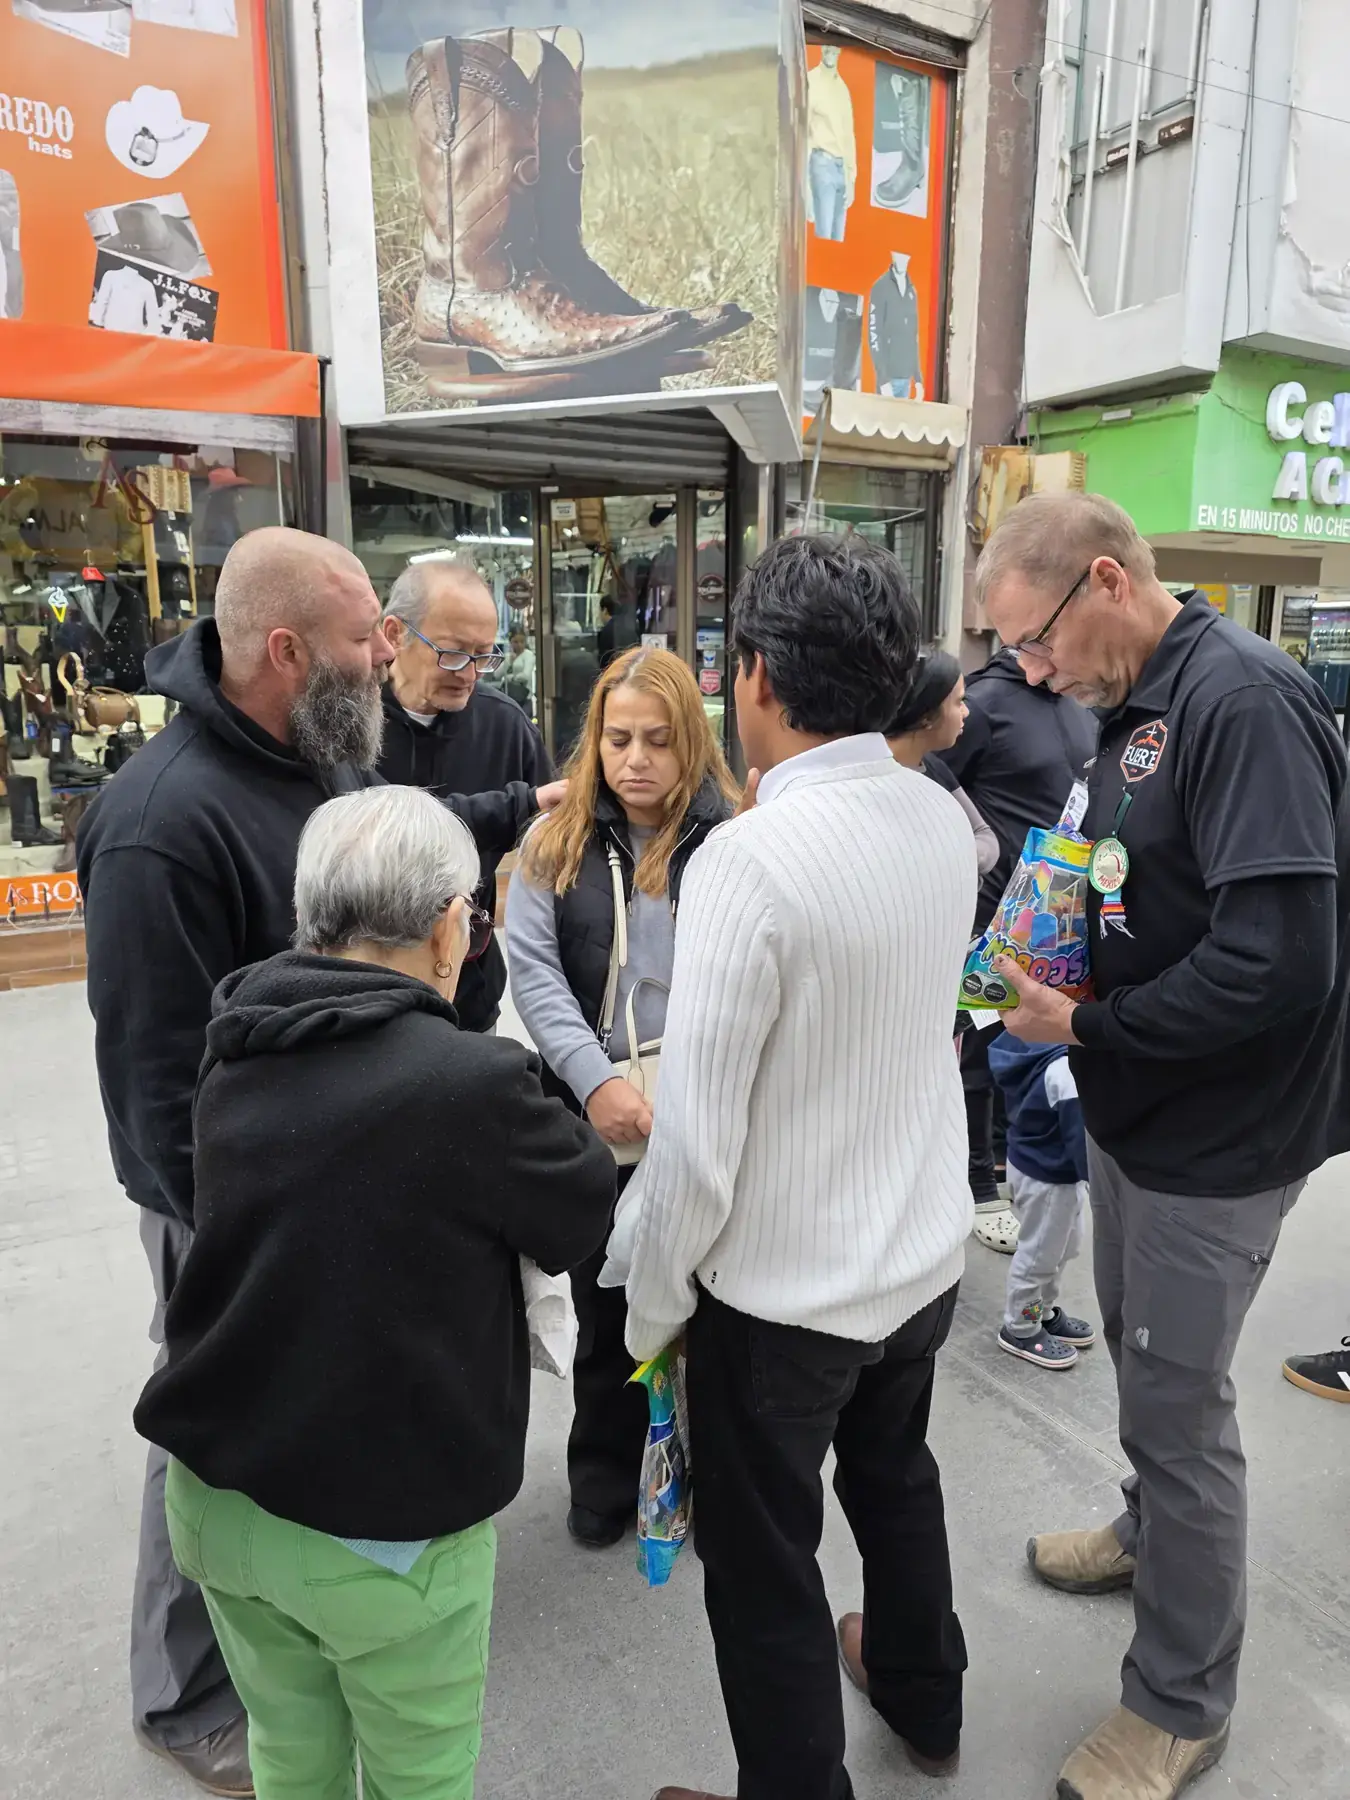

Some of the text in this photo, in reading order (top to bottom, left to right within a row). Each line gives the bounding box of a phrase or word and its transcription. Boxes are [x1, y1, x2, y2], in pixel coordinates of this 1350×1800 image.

[0, 92, 74, 143] REDO
[28, 136, 73, 159] hats
[869, 303, 880, 351] ARIAT
[1198, 505, 1217, 526] EN
[1221, 508, 1236, 528] 15
[1239, 508, 1299, 533] MINUTOS
[1304, 514, 1323, 535] NO
[31, 880, 79, 904] BO
